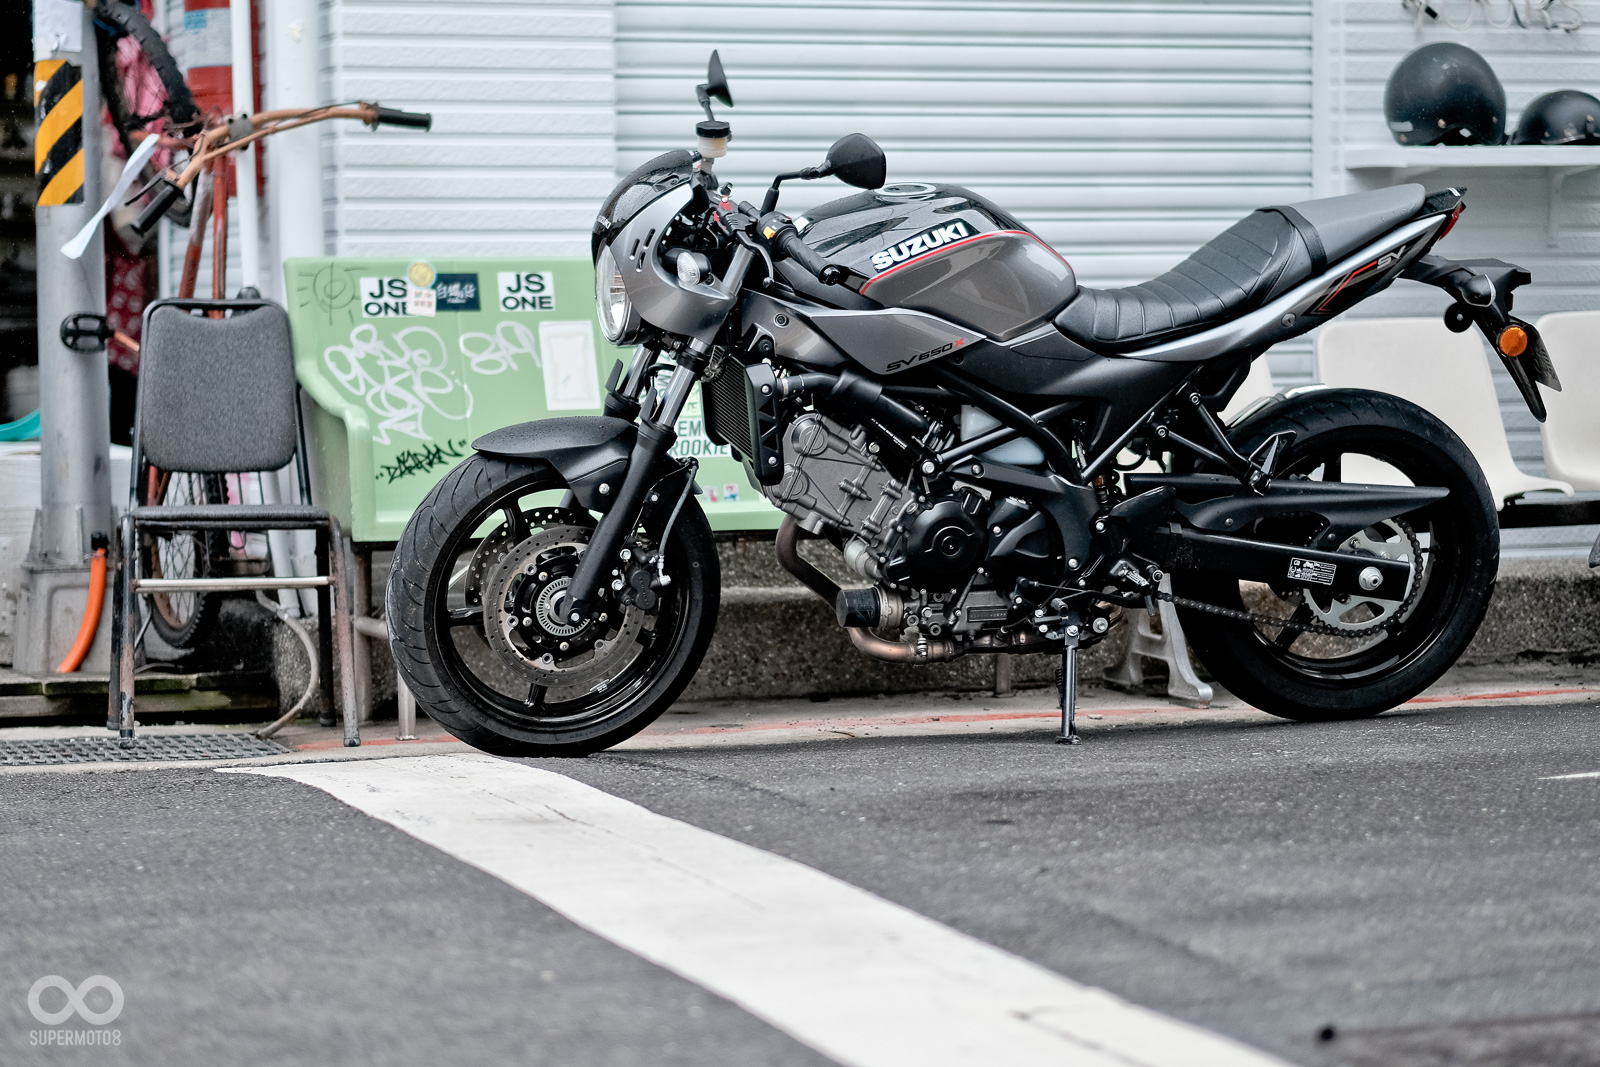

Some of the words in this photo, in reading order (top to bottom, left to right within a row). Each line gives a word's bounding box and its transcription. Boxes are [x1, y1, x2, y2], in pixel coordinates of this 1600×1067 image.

[871, 222, 969, 270] SUZUKI
[1377, 245, 1406, 269] SV
[369, 278, 408, 299] JS
[507, 274, 545, 293] JS
[502, 295, 553, 311] ONE
[885, 338, 965, 373] SV650X
[670, 439, 729, 456] ROOKIE
